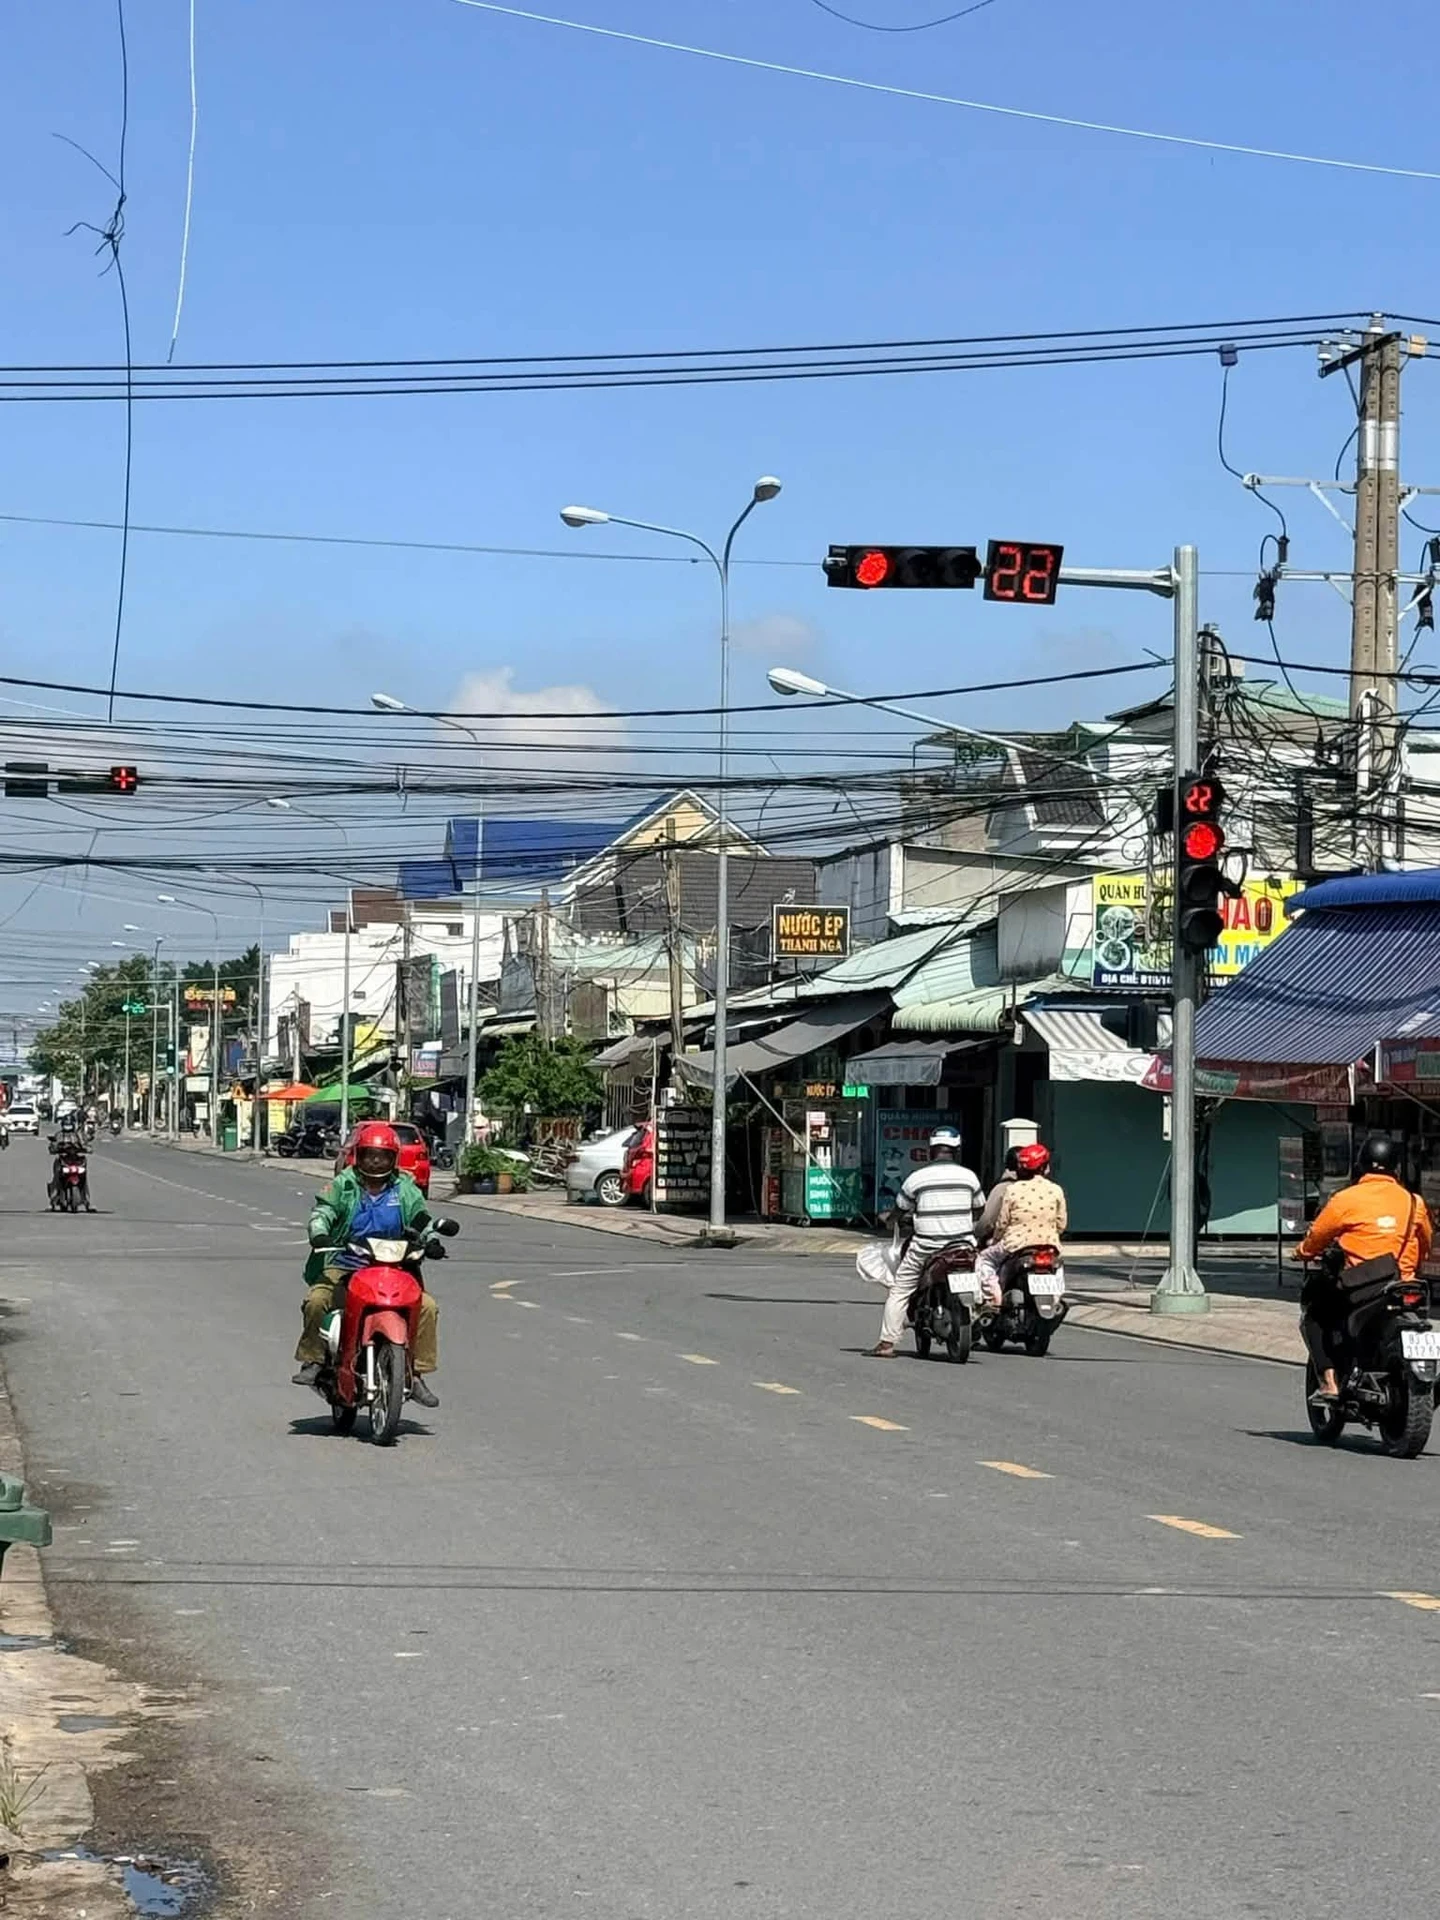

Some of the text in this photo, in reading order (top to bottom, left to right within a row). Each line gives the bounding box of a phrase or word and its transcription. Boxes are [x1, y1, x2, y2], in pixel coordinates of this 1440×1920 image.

[991, 546, 1054, 598] 22
[779, 911, 844, 936] NƯỚC ÉP
[780, 938, 842, 952] THANH NGA
